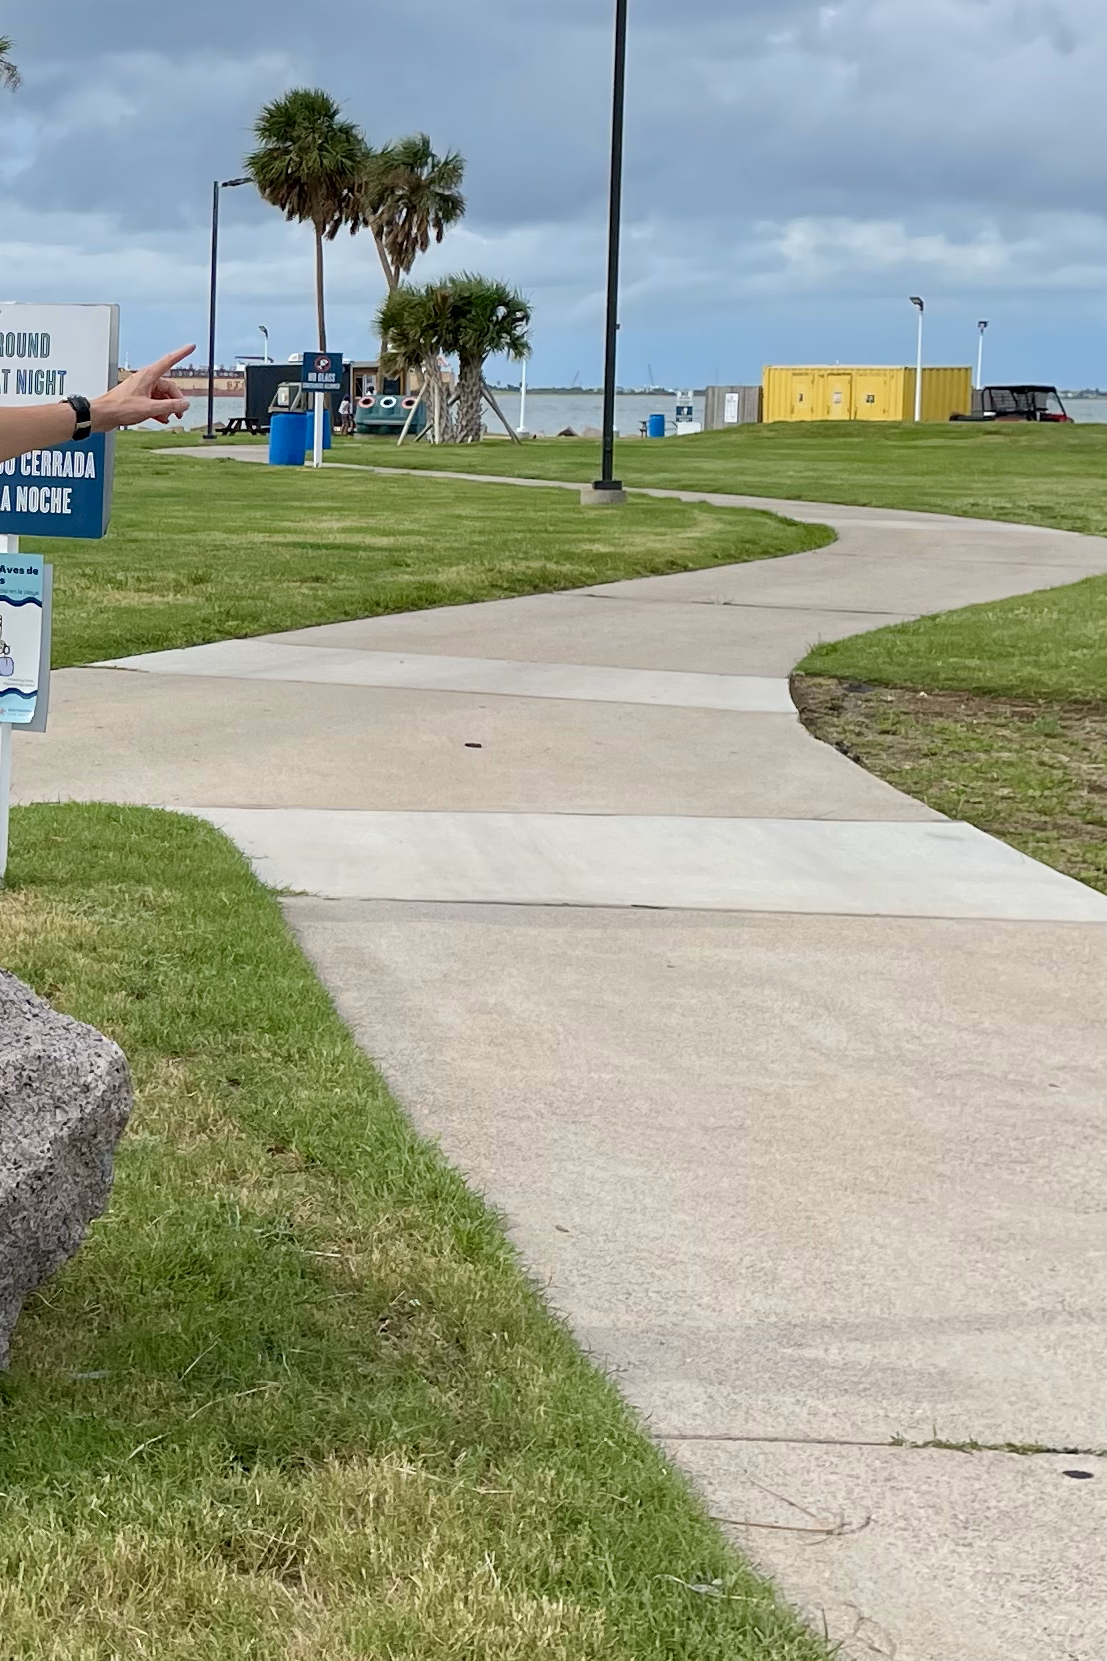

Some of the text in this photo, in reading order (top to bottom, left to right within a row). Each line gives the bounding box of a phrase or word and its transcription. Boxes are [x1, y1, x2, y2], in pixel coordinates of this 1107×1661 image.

[15, 369, 67, 396] NIGHT
[20, 449, 96, 479] CERRADA
[16, 485, 73, 514] NOCHE
[0, 564, 25, 574] Aves
[26, 566, 39, 575] de
